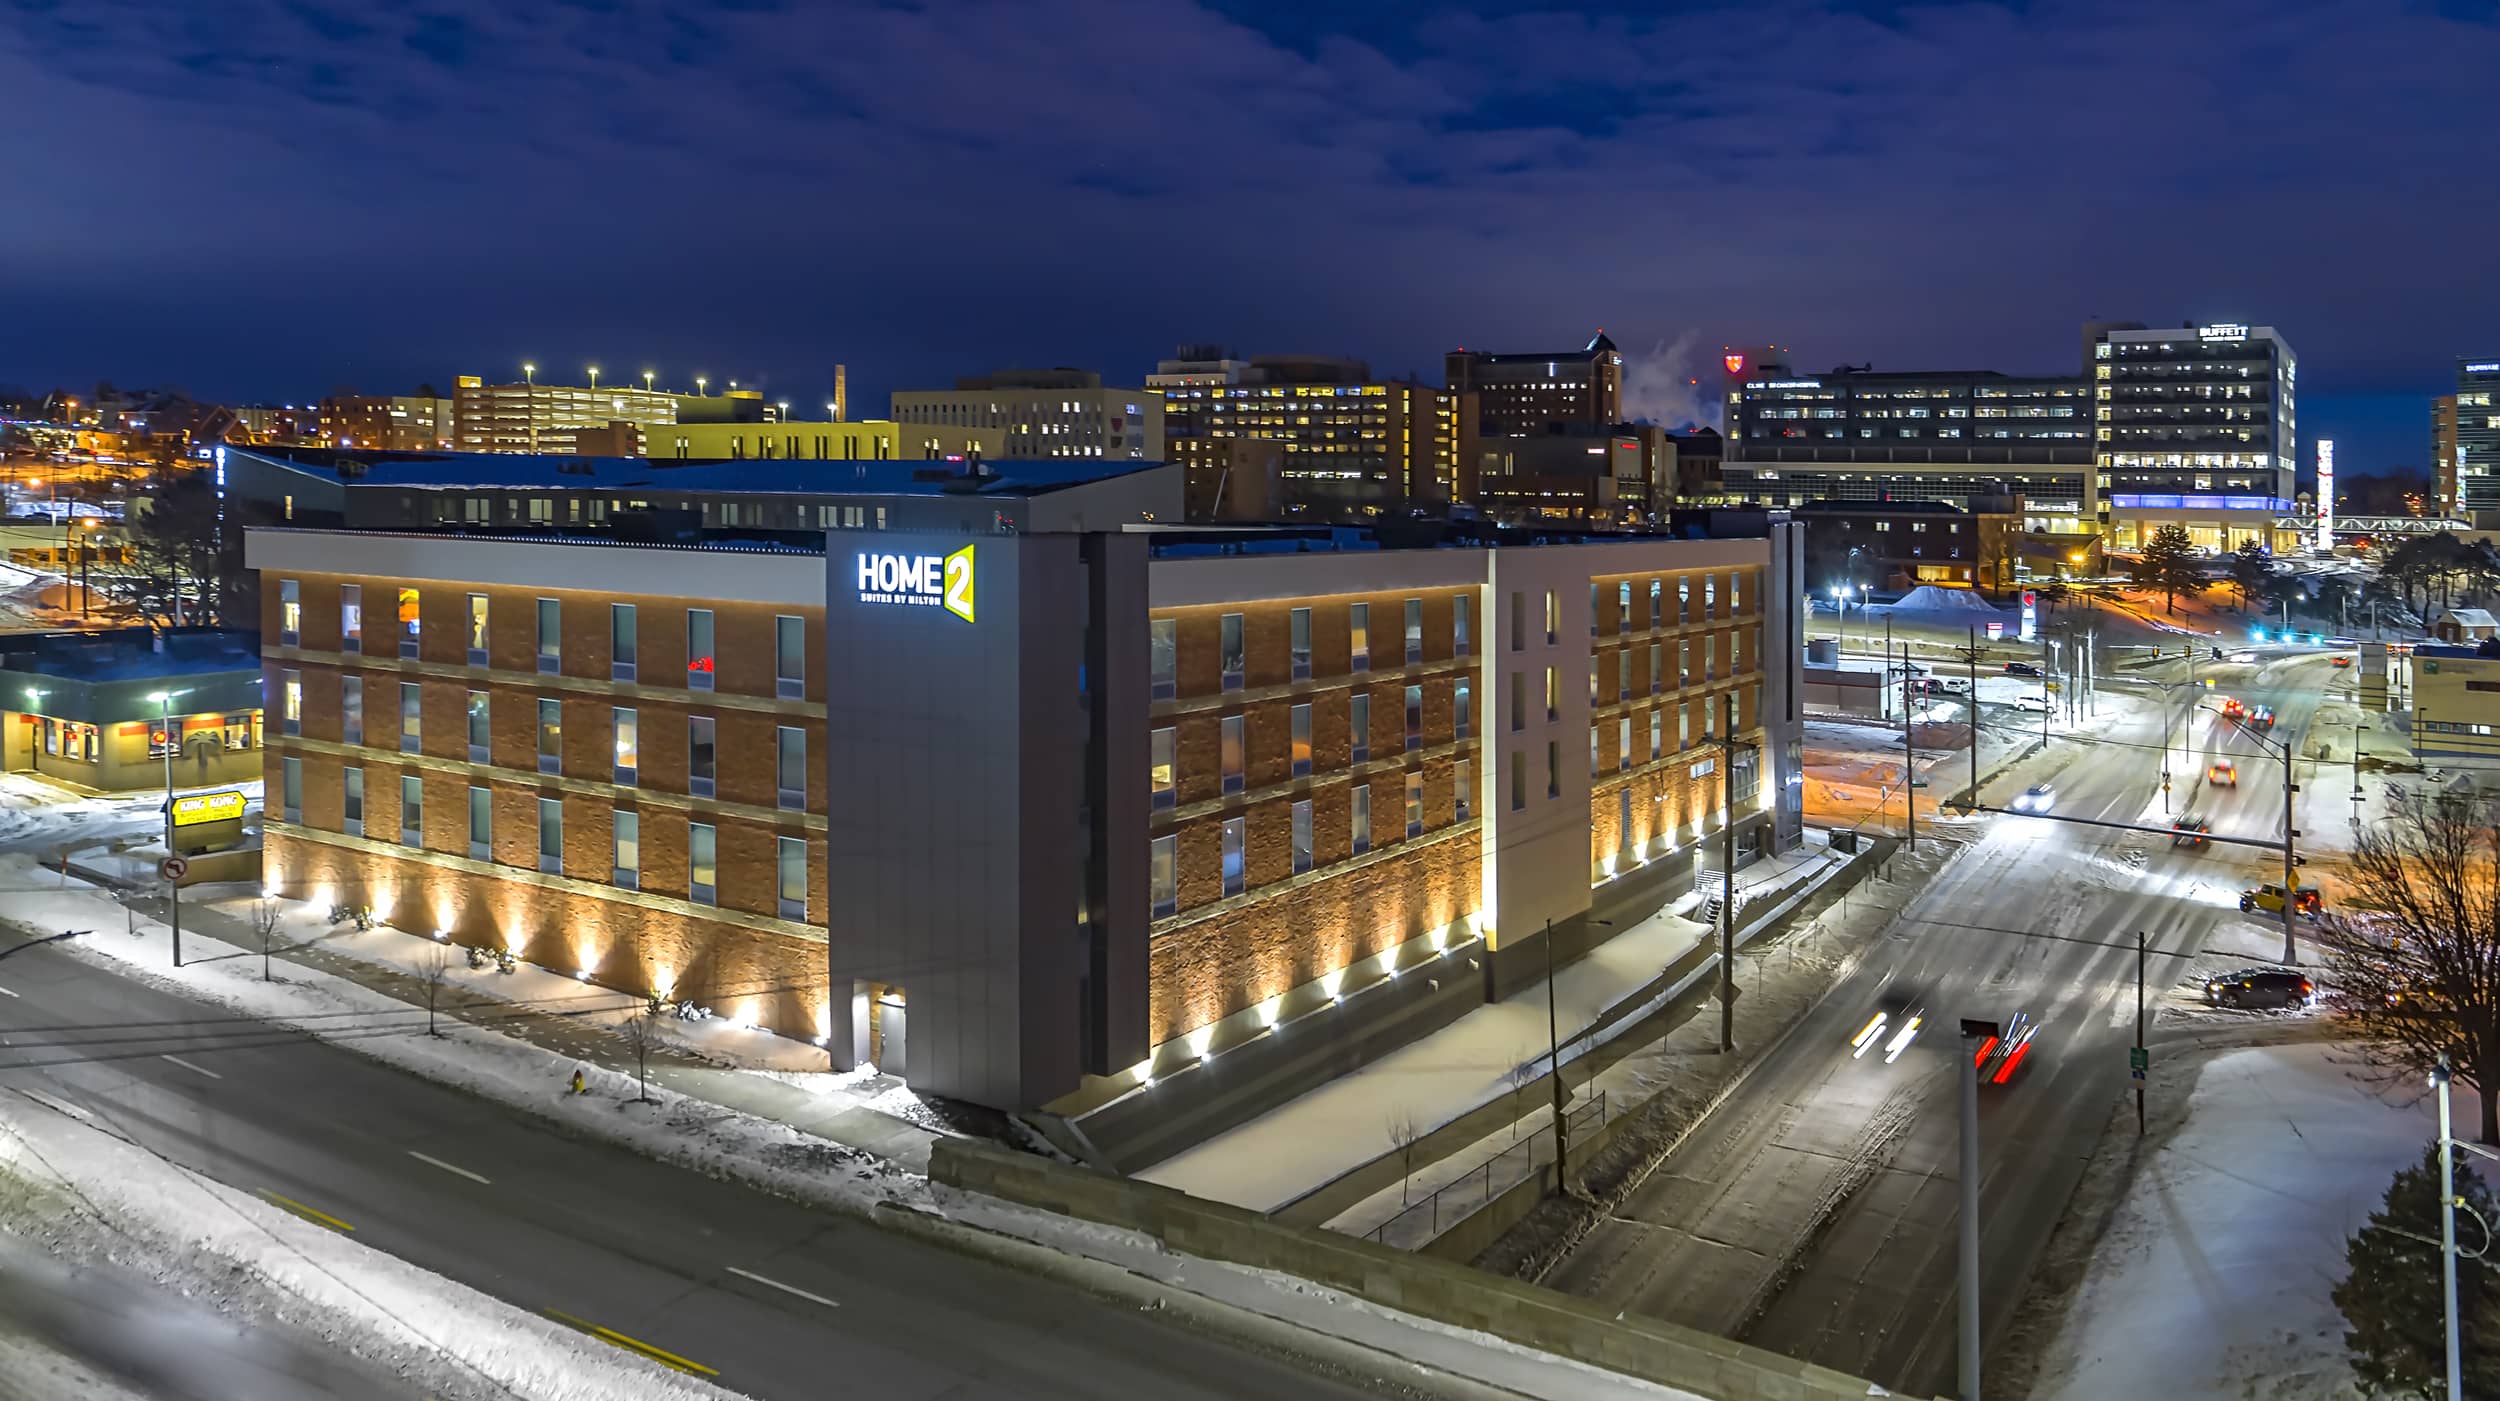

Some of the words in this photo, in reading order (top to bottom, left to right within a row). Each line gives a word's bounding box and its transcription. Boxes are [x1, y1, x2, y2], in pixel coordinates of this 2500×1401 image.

[2200, 327, 2248, 336] BUFFETT
[858, 553, 943, 594] HOME
[947, 555, 971, 616] 2
[860, 592, 892, 604] SUITES
[894, 594, 907, 605] BY
[908, 595, 941, 606] HILTON
[180, 799, 205, 812] KING
[209, 795, 237, 808] KONG
